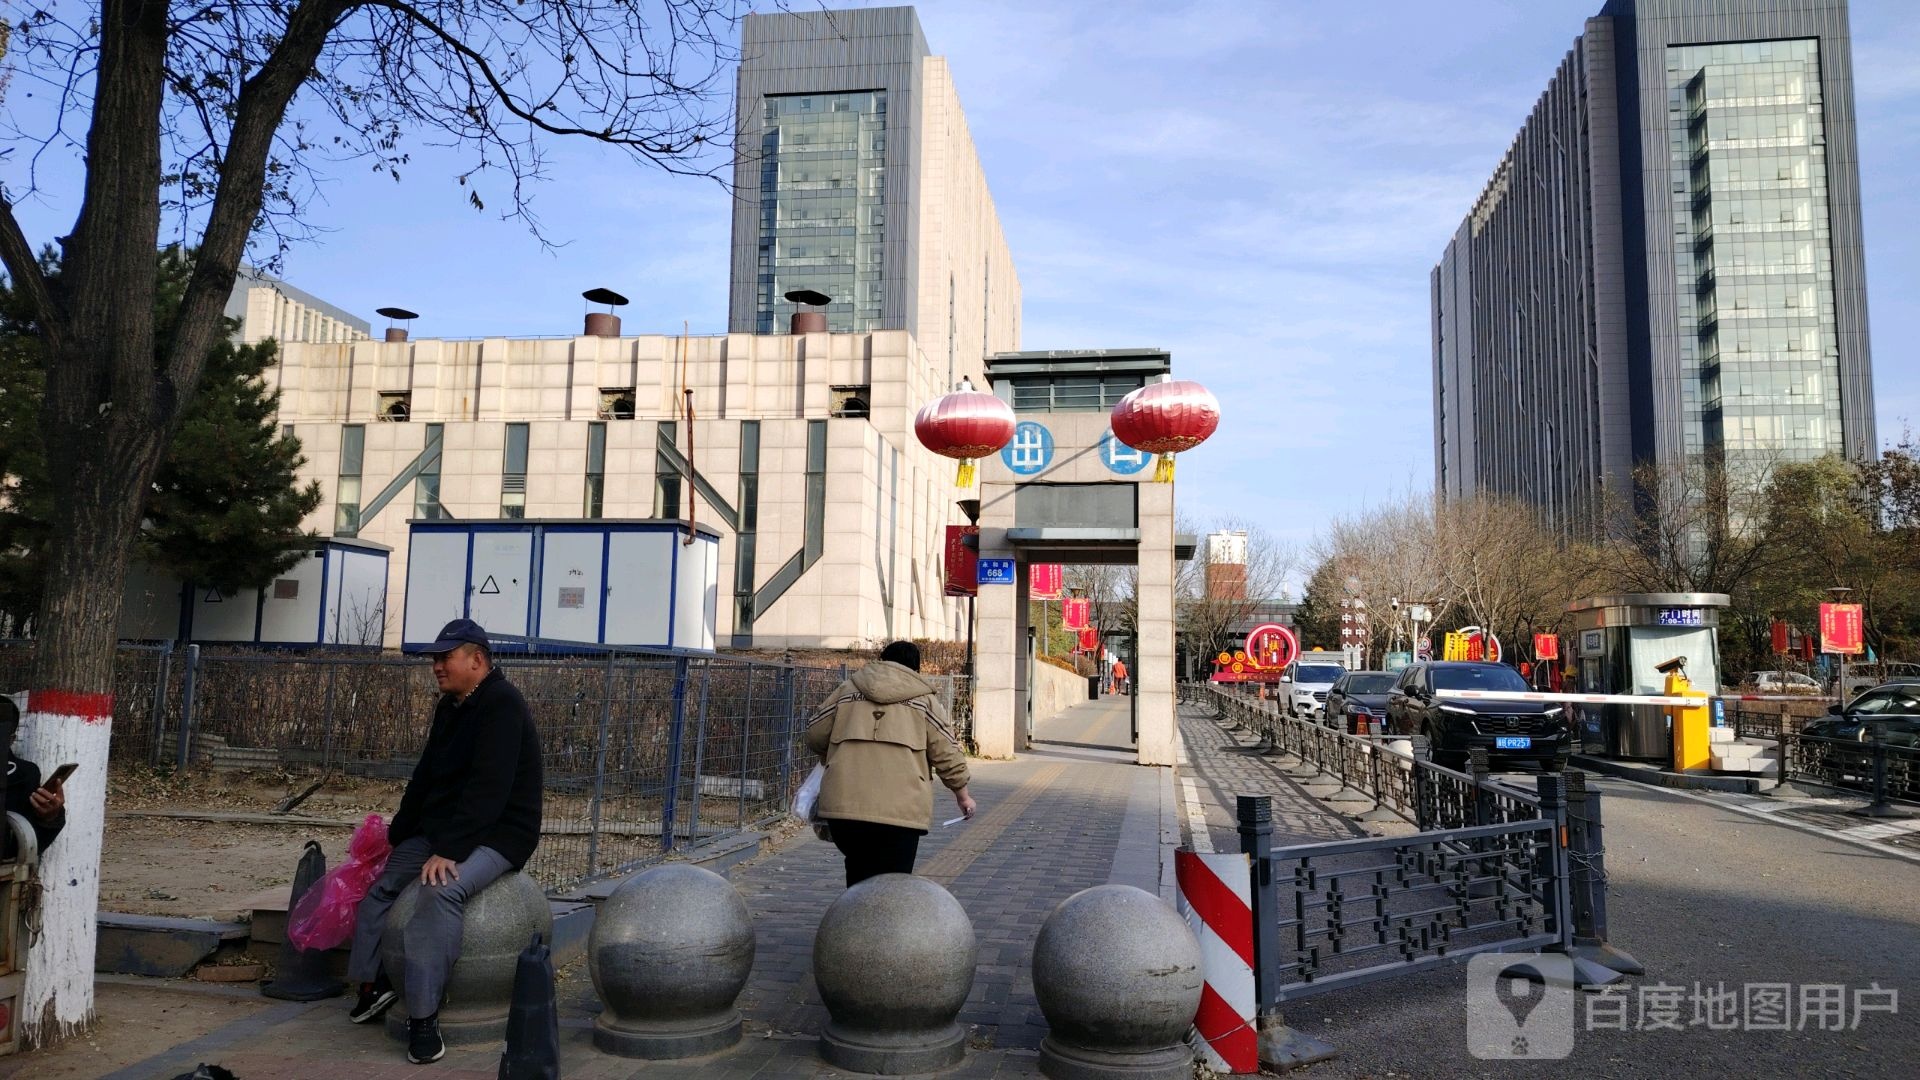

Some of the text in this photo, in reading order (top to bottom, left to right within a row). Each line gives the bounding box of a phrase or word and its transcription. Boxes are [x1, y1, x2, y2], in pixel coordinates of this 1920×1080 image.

[987, 569, 1003, 577] 668
[1660, 609, 1701, 619] 开门时间
